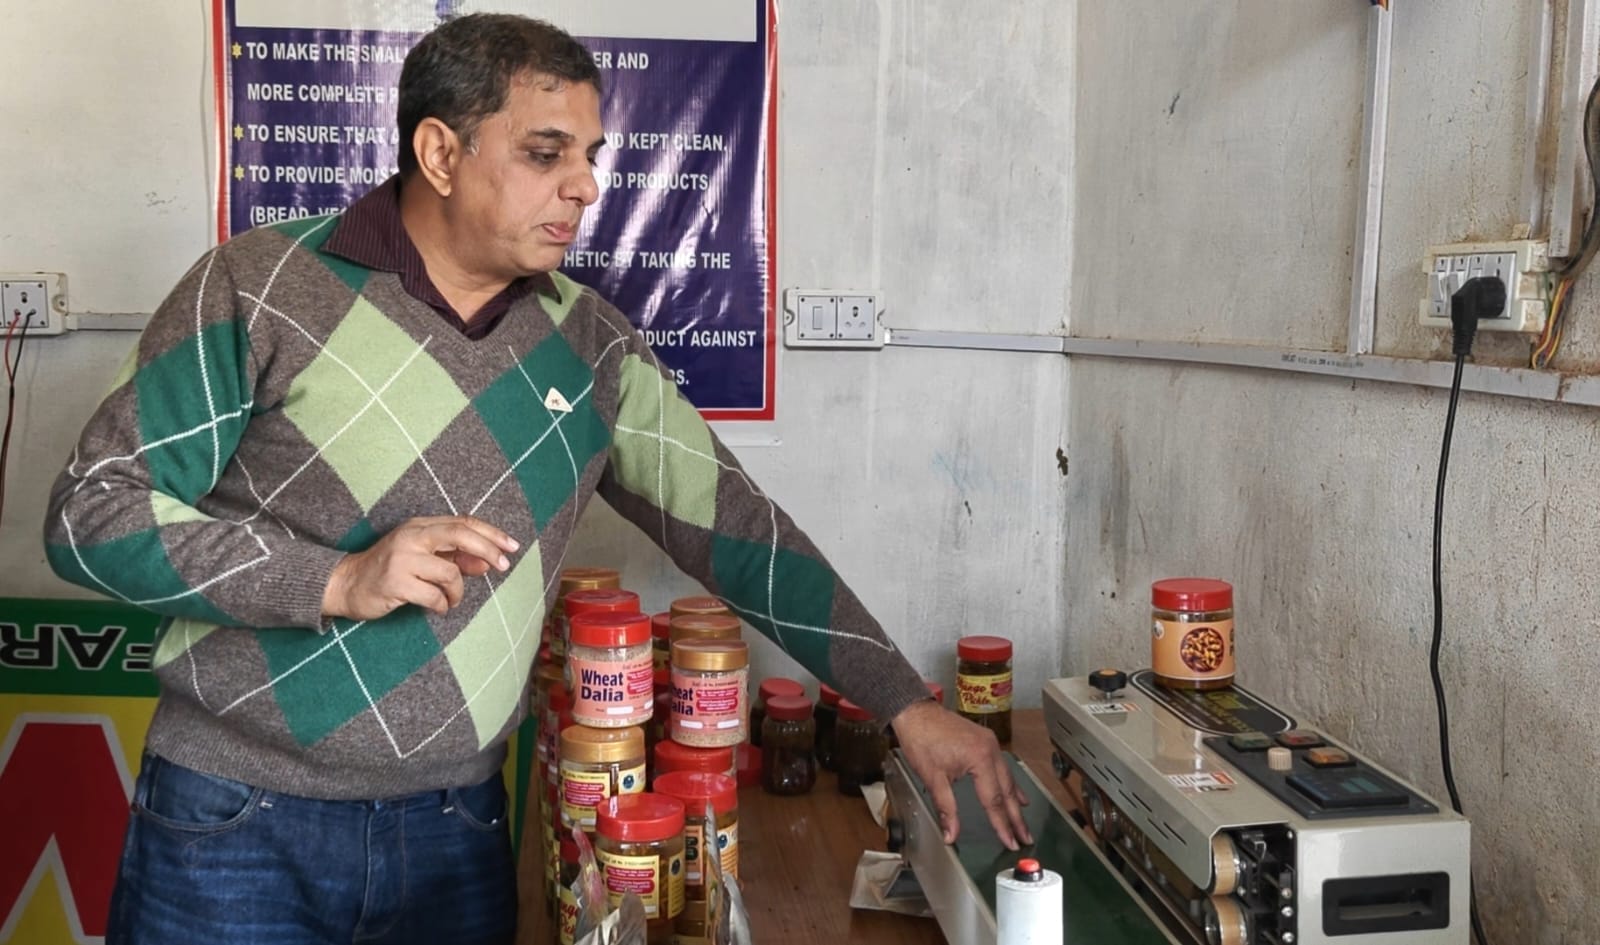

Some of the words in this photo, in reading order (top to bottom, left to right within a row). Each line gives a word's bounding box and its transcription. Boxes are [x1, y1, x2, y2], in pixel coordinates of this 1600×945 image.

[246, 42, 268, 59] TO
[272, 43, 319, 61] MAKE
[323, 44, 355, 62] THE
[360, 45, 409, 63] SMAL
[593, 51, 613, 69] ER
[617, 52, 649, 70] AND
[247, 83, 293, 101] MORE
[298, 84, 385, 103] COMPLETE
[247, 124, 269, 142] TO
[274, 125, 339, 143] ENSURE
[343, 126, 386, 144] THAT
[604, 132, 624, 149] ND
[629, 133, 668, 150] KEPT
[249, 165, 270, 182] TO
[275, 166, 345, 184] PROVIDE
[627, 172, 709, 190] PRODUCTS
[564, 251, 610, 268] HETIC
[615, 251, 633, 267] BY
[639, 252, 697, 269] TAKING
[701, 252, 731, 269] THE
[690, 330, 756, 347] AGAINST
[581, 668, 624, 686] Wheat
[581, 686, 624, 703] Dalia
[672, 701, 694, 716] alia
